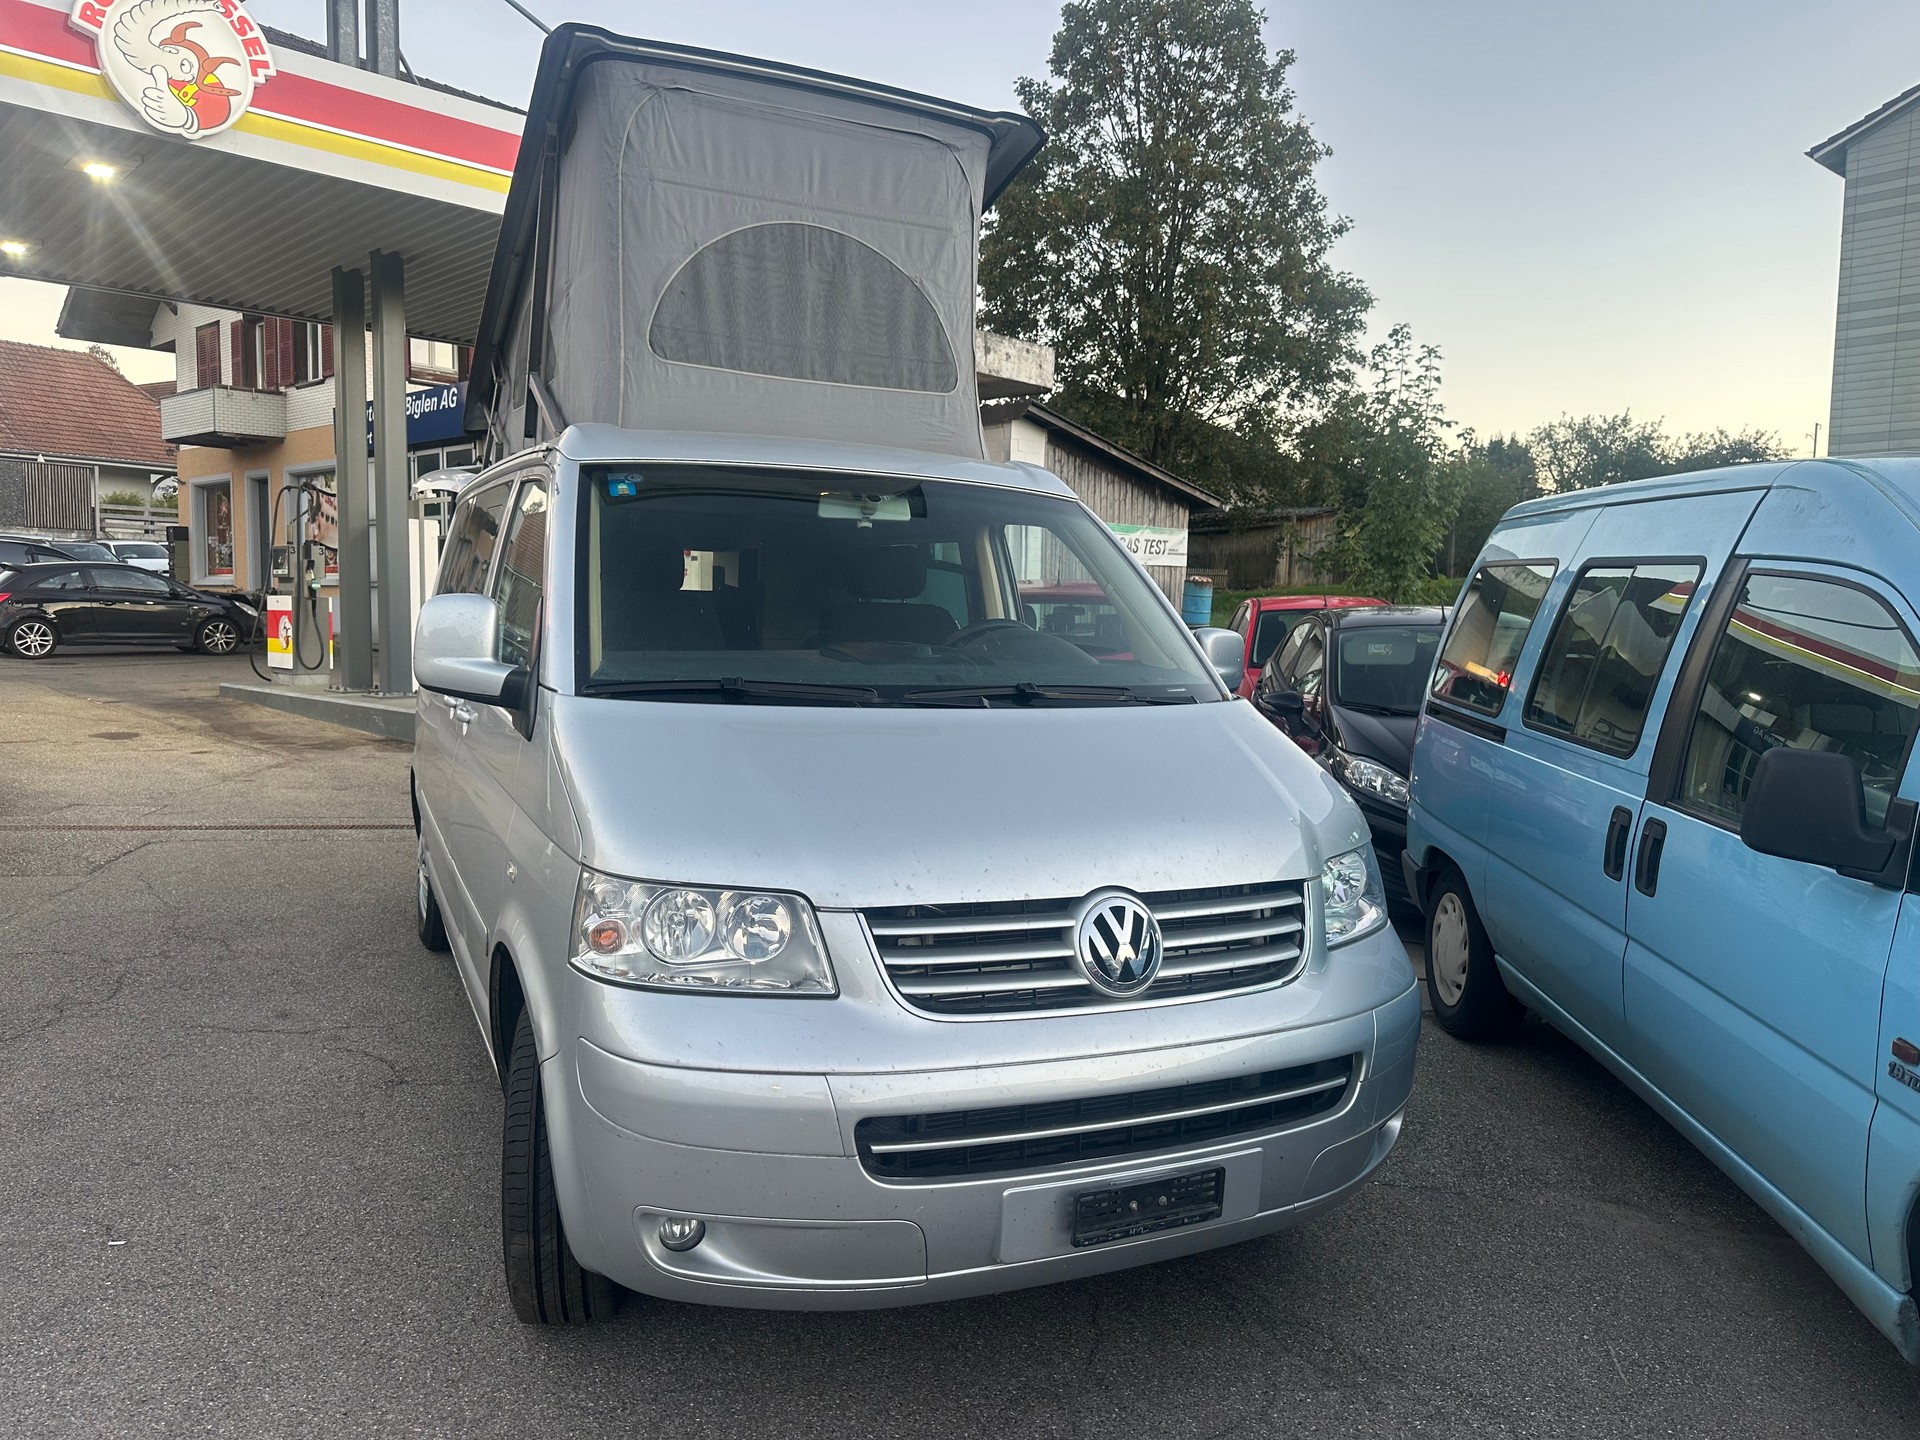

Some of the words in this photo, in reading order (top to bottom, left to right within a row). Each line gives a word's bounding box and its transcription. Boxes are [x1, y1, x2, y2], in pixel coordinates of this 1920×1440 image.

[406, 393, 437, 419] Biglen
[440, 387, 458, 410] AG
[290, 546, 296, 555] 3
[319, 547, 325, 556] 3
[1143, 538, 1168, 555] TEST
[1079, 895, 1158, 989] VW
